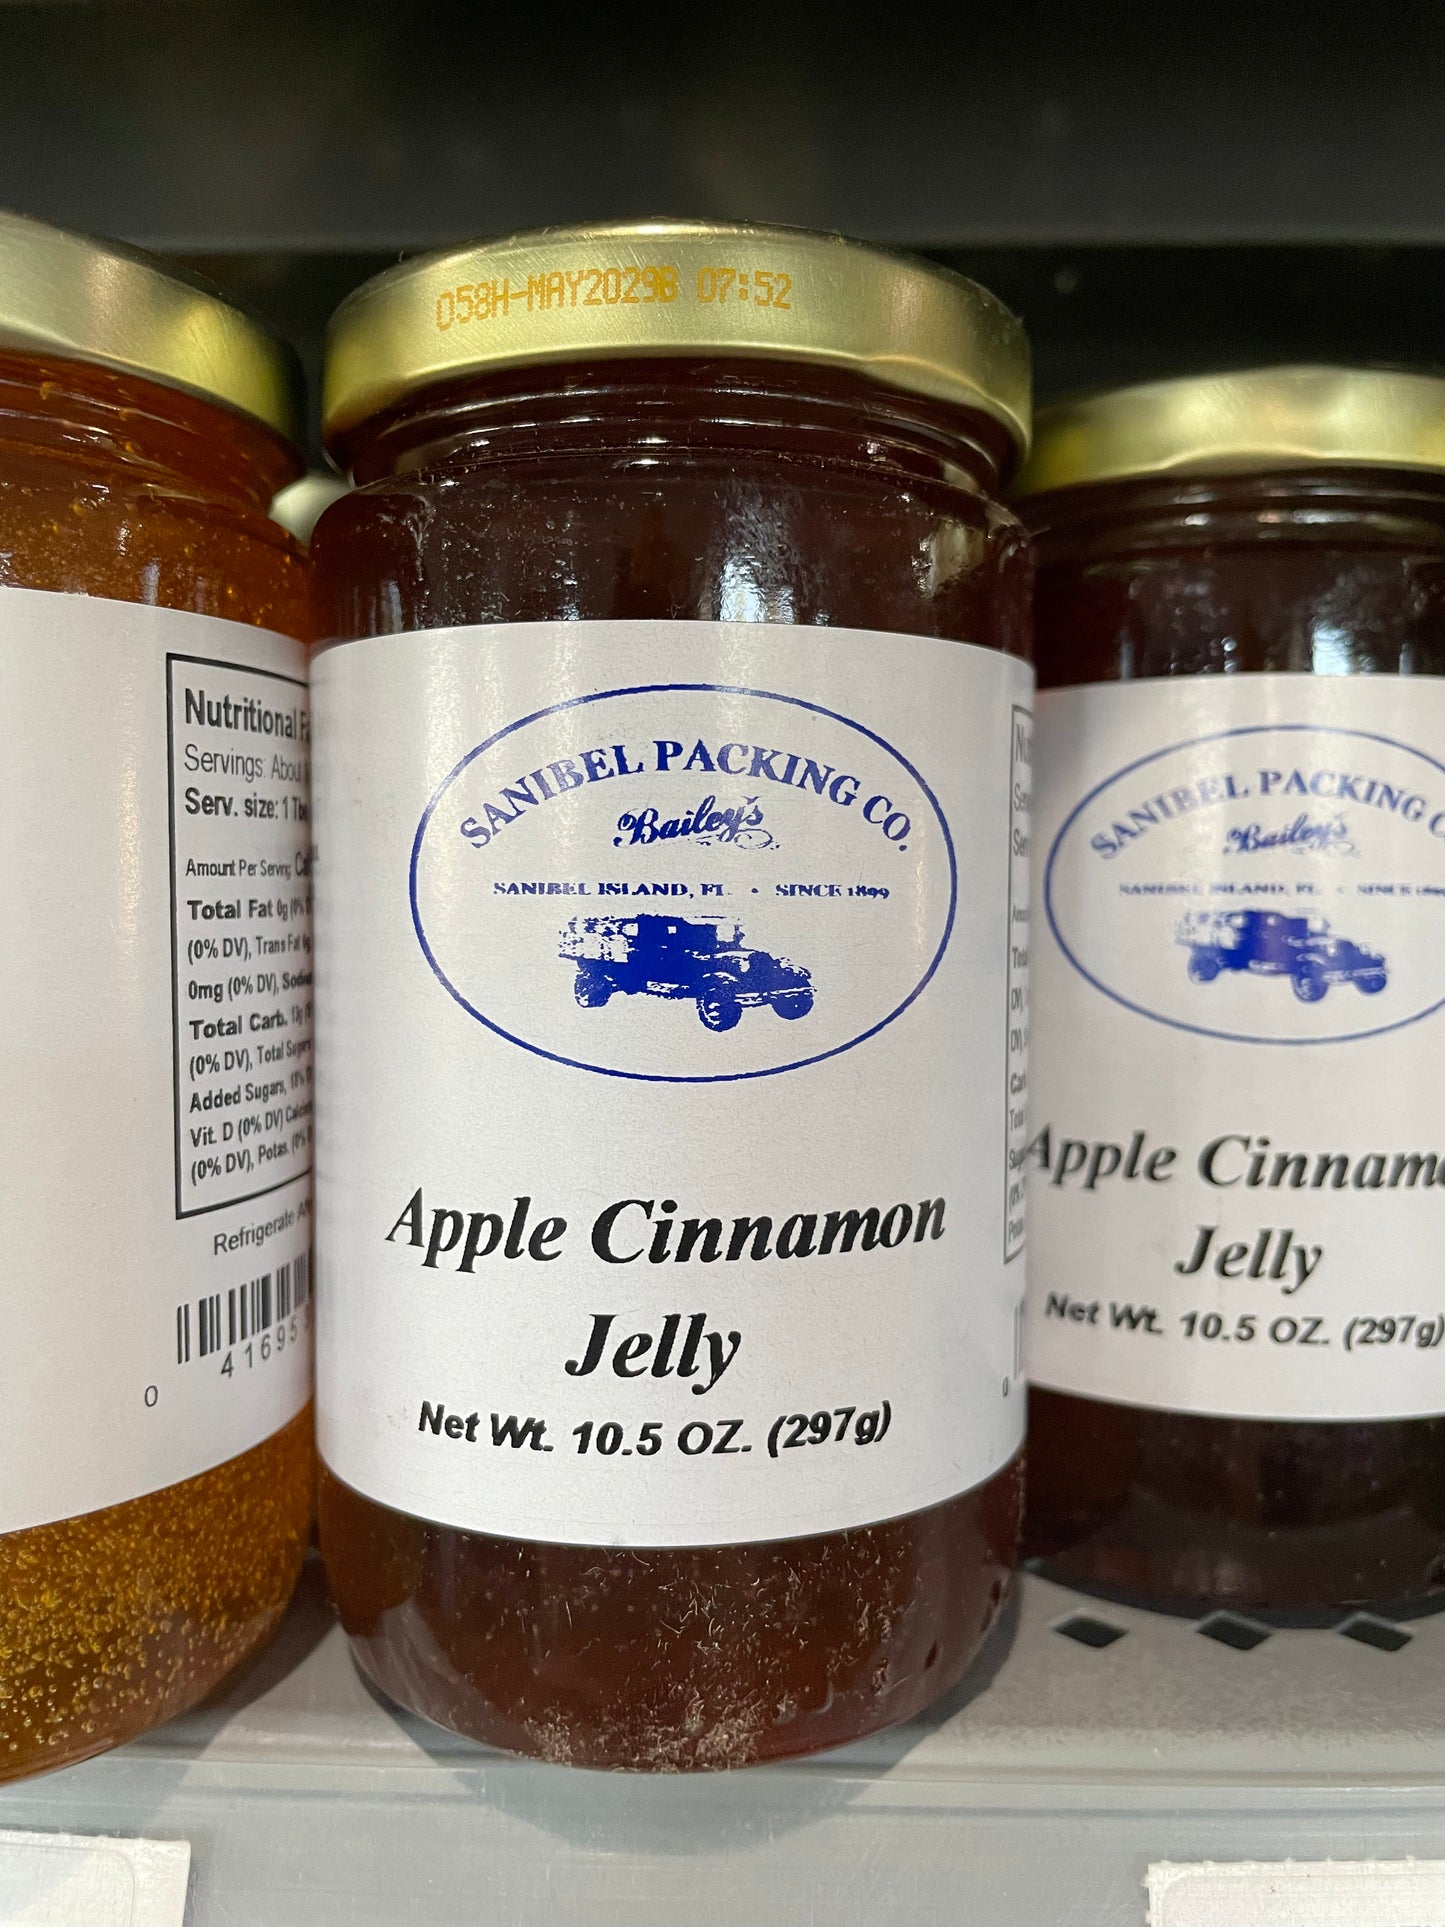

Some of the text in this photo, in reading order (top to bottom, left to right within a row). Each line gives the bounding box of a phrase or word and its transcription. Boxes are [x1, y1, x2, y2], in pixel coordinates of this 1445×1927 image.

[697, 266, 793, 310] 07:52
[185, 687, 297, 740] Nutritional
[271, 754, 306, 783] Abou
[184, 787, 239, 817] Serv.
[244, 792, 279, 820] size:
[460, 739, 912, 852] SANIBEL PACKING CO.
[1090, 774, 1250, 860] SANIBEL
[1257, 768, 1426, 823] PACKING
[614, 795, 780, 850] Bailey's
[186, 858, 237, 876] Amount
[239, 858, 257, 877] Per
[187, 899, 241, 920] Total
[248, 898, 274, 919] Fat
[493, 882, 592, 896] SANIBEL
[597, 882, 694, 899] ISLAND,
[775, 884, 842, 897] SINCE
[847, 885, 890, 900] 1899
[188, 938, 219, 966] (0%
[222, 936, 252, 961] DV),
[255, 935, 286, 957] Trans
[188, 980, 224, 1004] 0mg
[227, 976, 254, 1002] (0%
[256, 972, 279, 997] DV),
[189, 1015, 243, 1042] Total
[249, 1009, 289, 1033] Carb.
[189, 1054, 221, 1082] (0%
[223, 1047, 253, 1074] DV),
[256, 1041, 284, 1065] Total
[189, 1084, 242, 1114] Added
[245, 1079, 287, 1105] Sugars,
[190, 1128, 217, 1149] Vit.
[222, 1121, 234, 1142] D
[237, 1112, 263, 1144] (0%
[191, 1159, 223, 1187] (0%
[225, 1149, 255, 1176] DV),
[1020, 1123, 1176, 1191] Apple
[213, 1208, 296, 1256] Refrigerate
[385, 1187, 947, 1273] Apple Cinnamon
[1173, 1224, 1322, 1296] Jelly
[1045, 1292, 1445, 1352] Net Wt. 10.5 OZ. (297g)
[564, 1312, 742, 1395] Jelly
[418, 1400, 891, 1458] Net Wt. 10.5 OZ. (297g)
